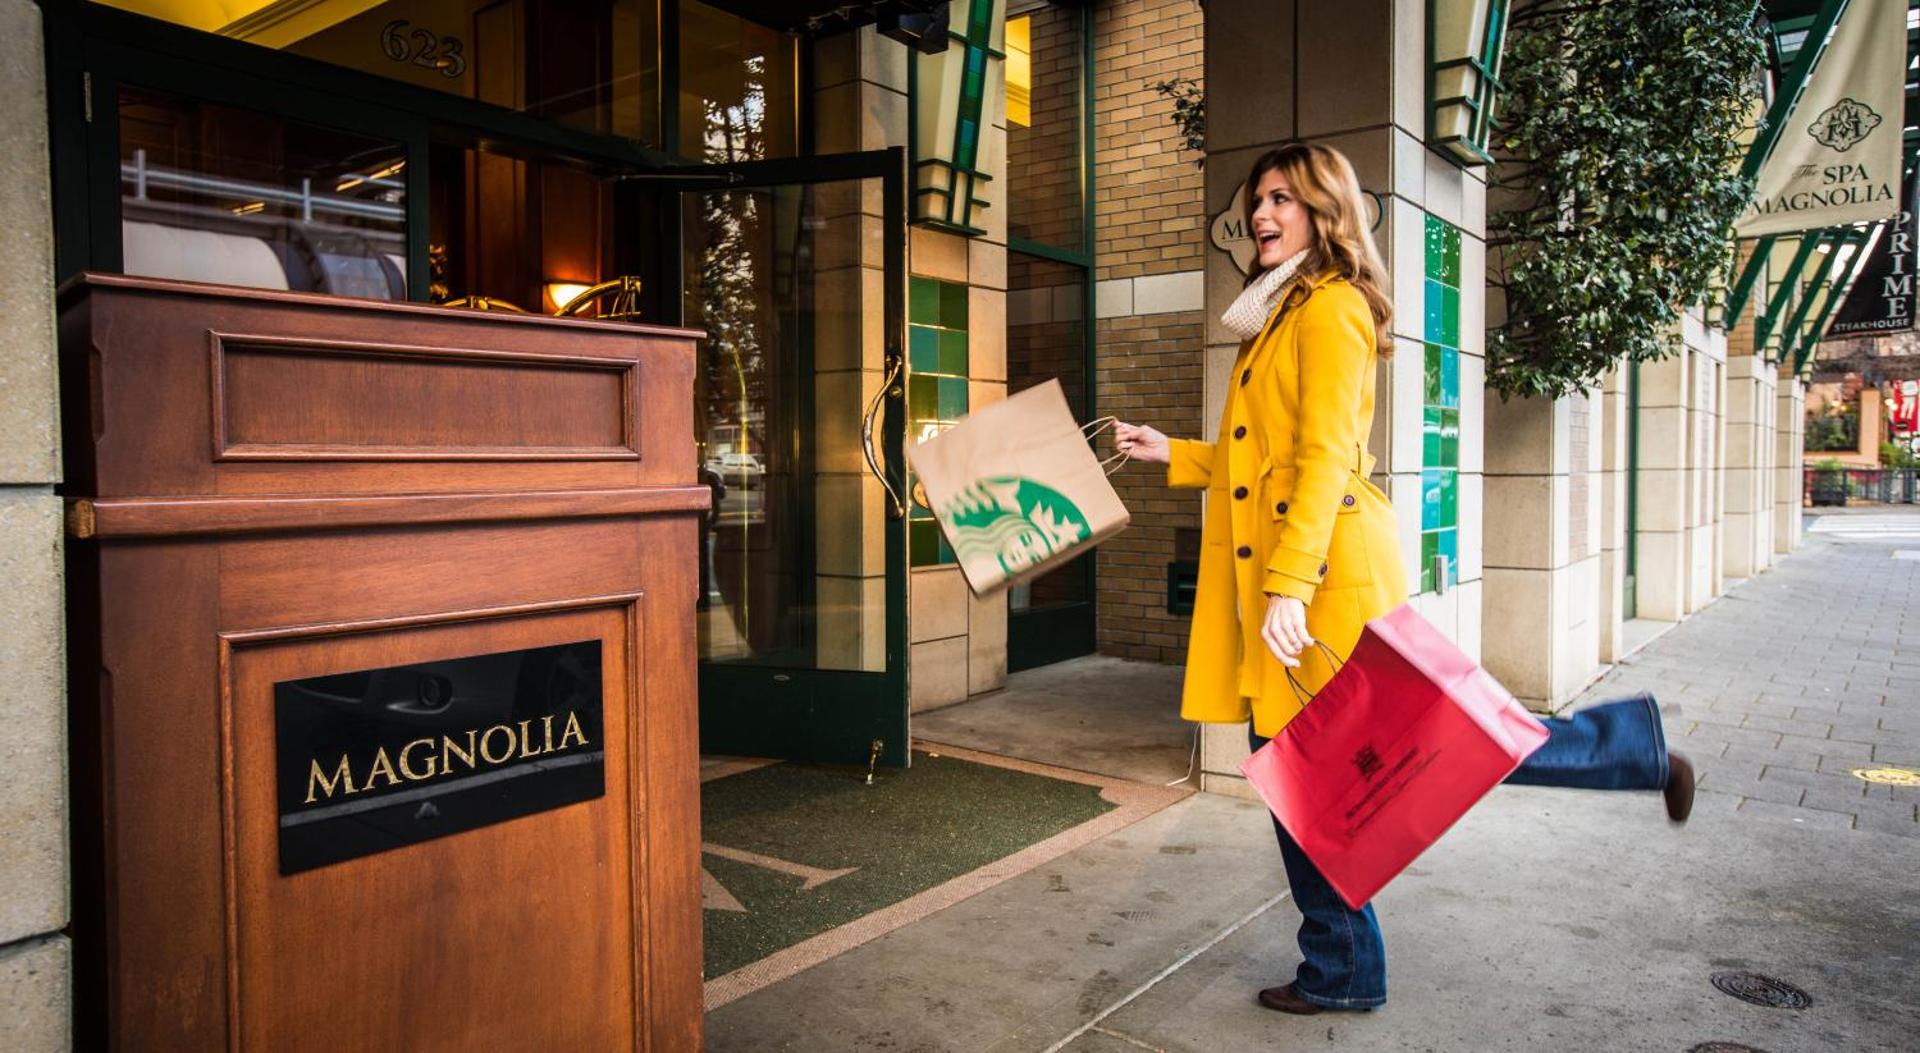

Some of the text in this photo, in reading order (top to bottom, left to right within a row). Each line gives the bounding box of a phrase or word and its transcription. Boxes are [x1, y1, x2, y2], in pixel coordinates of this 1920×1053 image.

[381, 20, 466, 78] 623
[1822, 164, 1869, 185] SPA
[1750, 184, 1894, 215] MAGNOLIA
[1881, 211, 1913, 319] PRIME
[1834, 318, 1910, 333] STEAKHOUSE
[304, 711, 590, 803] MAGNOLIA
